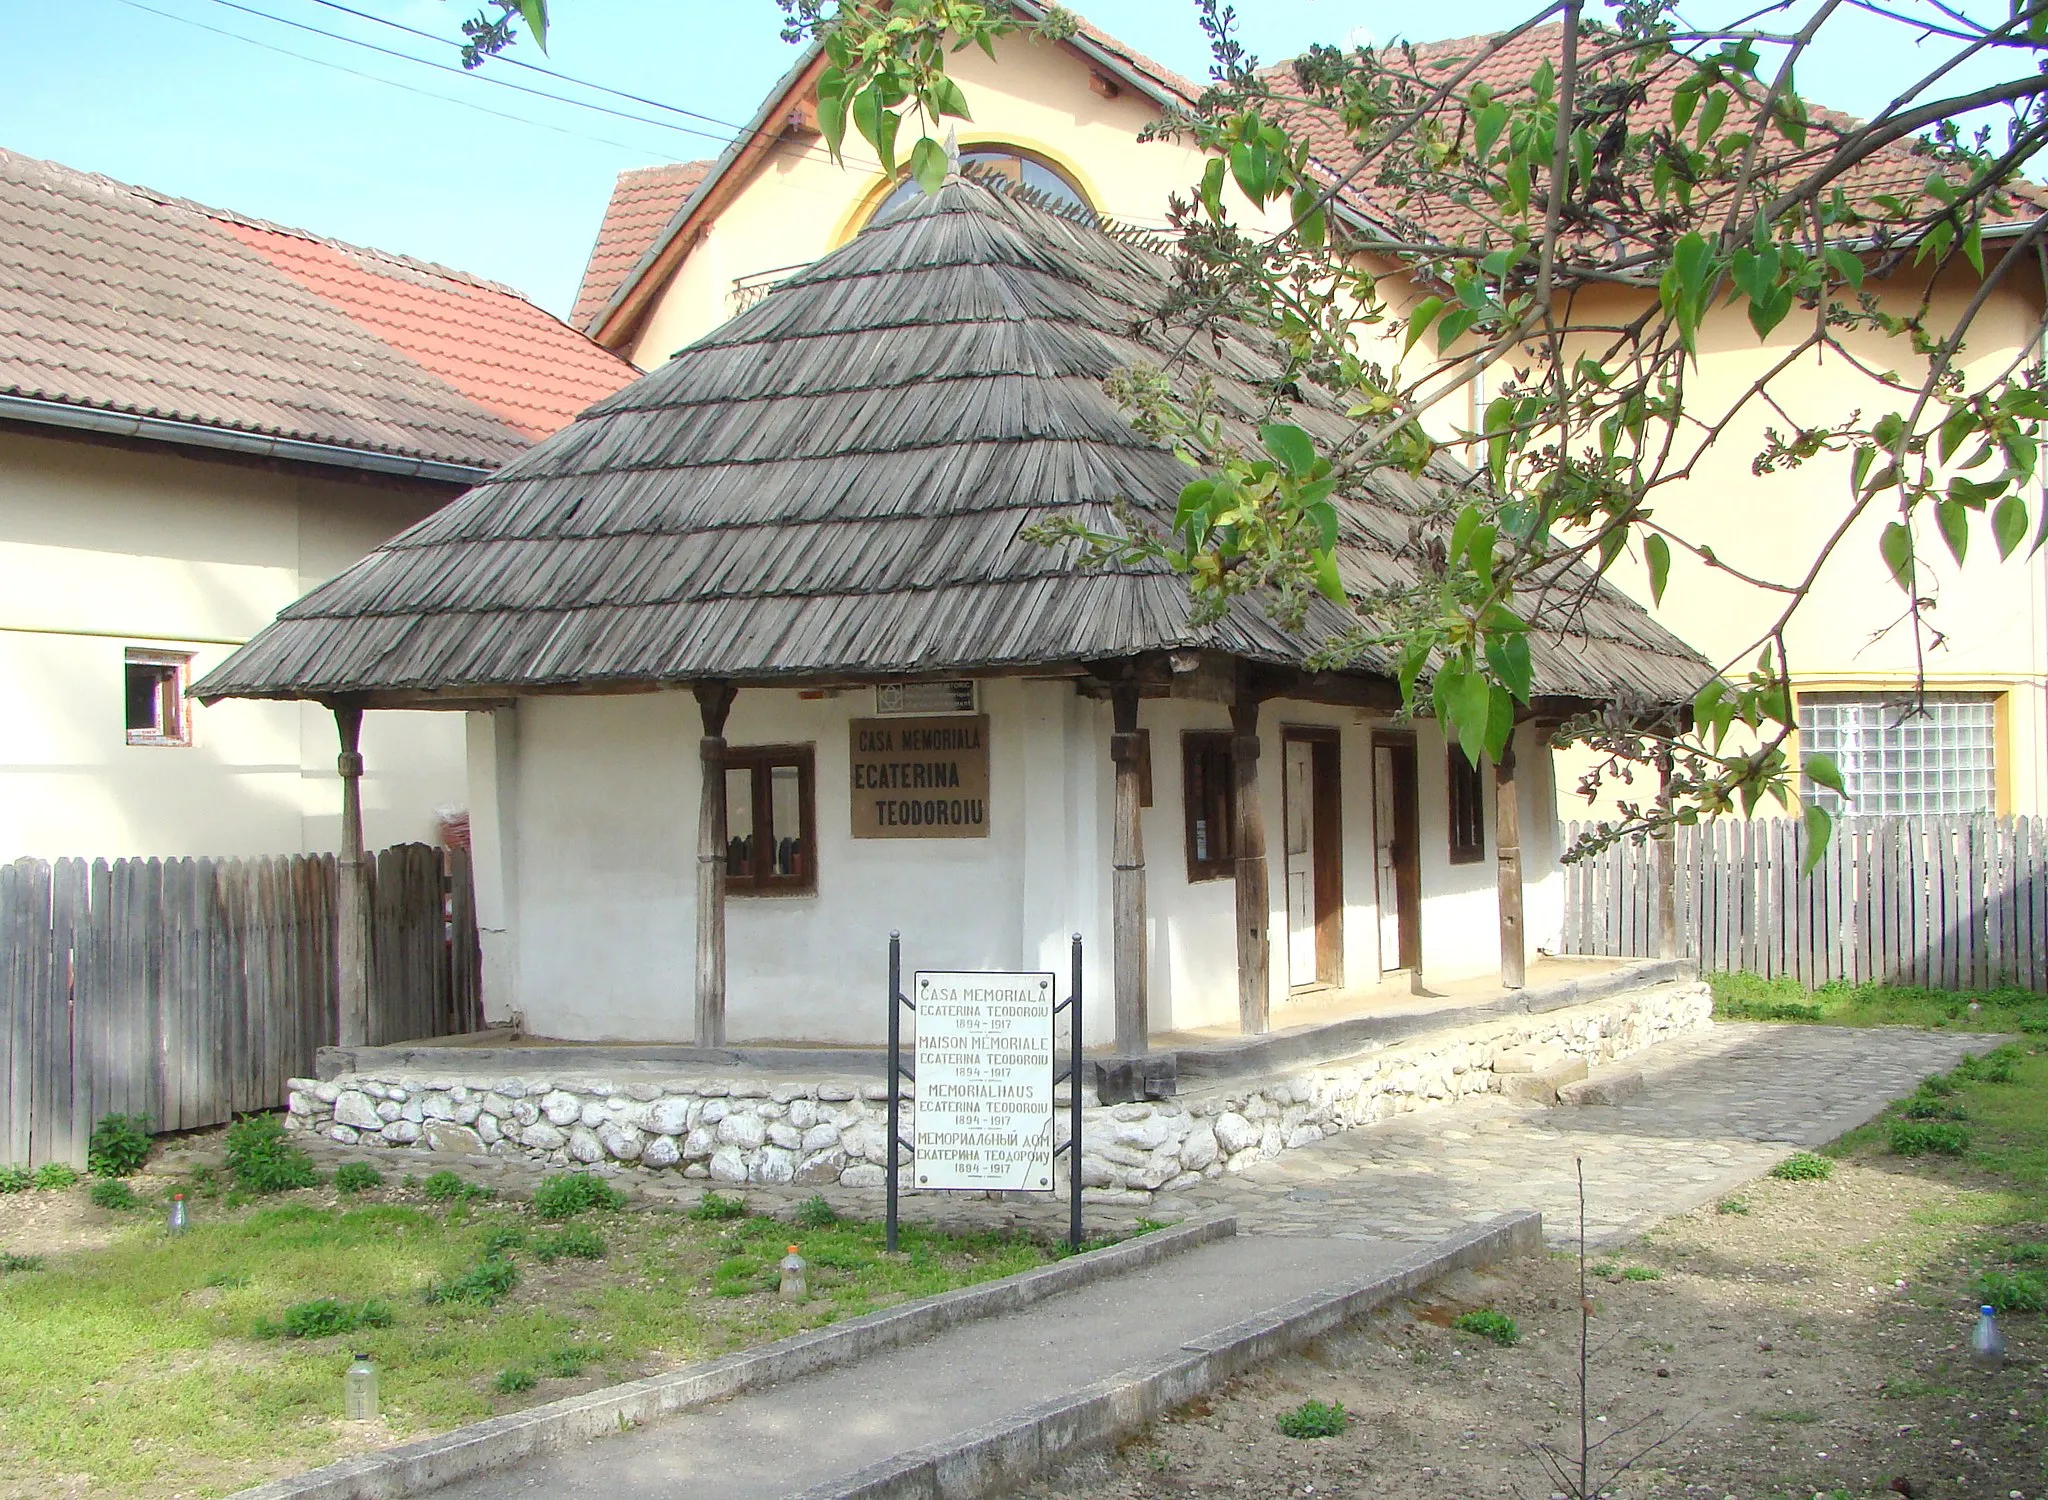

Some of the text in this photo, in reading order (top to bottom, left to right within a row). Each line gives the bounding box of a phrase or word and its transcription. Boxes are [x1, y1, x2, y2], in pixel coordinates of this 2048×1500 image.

[859, 731, 892, 751] CASA
[855, 761, 959, 789] ECATERINA
[875, 799, 982, 826] TEODOROIU
[921, 989, 957, 1001] CASA
[920, 1006, 1048, 1017] ECATERINA TEODOROIU
[919, 1036, 967, 1049] MAISON
[920, 1054, 1048, 1065] ECATERINA TEODOROIU
[929, 1085, 1034, 1097] MEMORIALHAUS
[920, 1101, 1048, 1114] ECATERINA TEODOROIU
[1022, 1134, 1050, 1148] ДОМ
[917, 1149, 1050, 1166] ЕКАТЕРИНА ТЕОДОРОИУ
